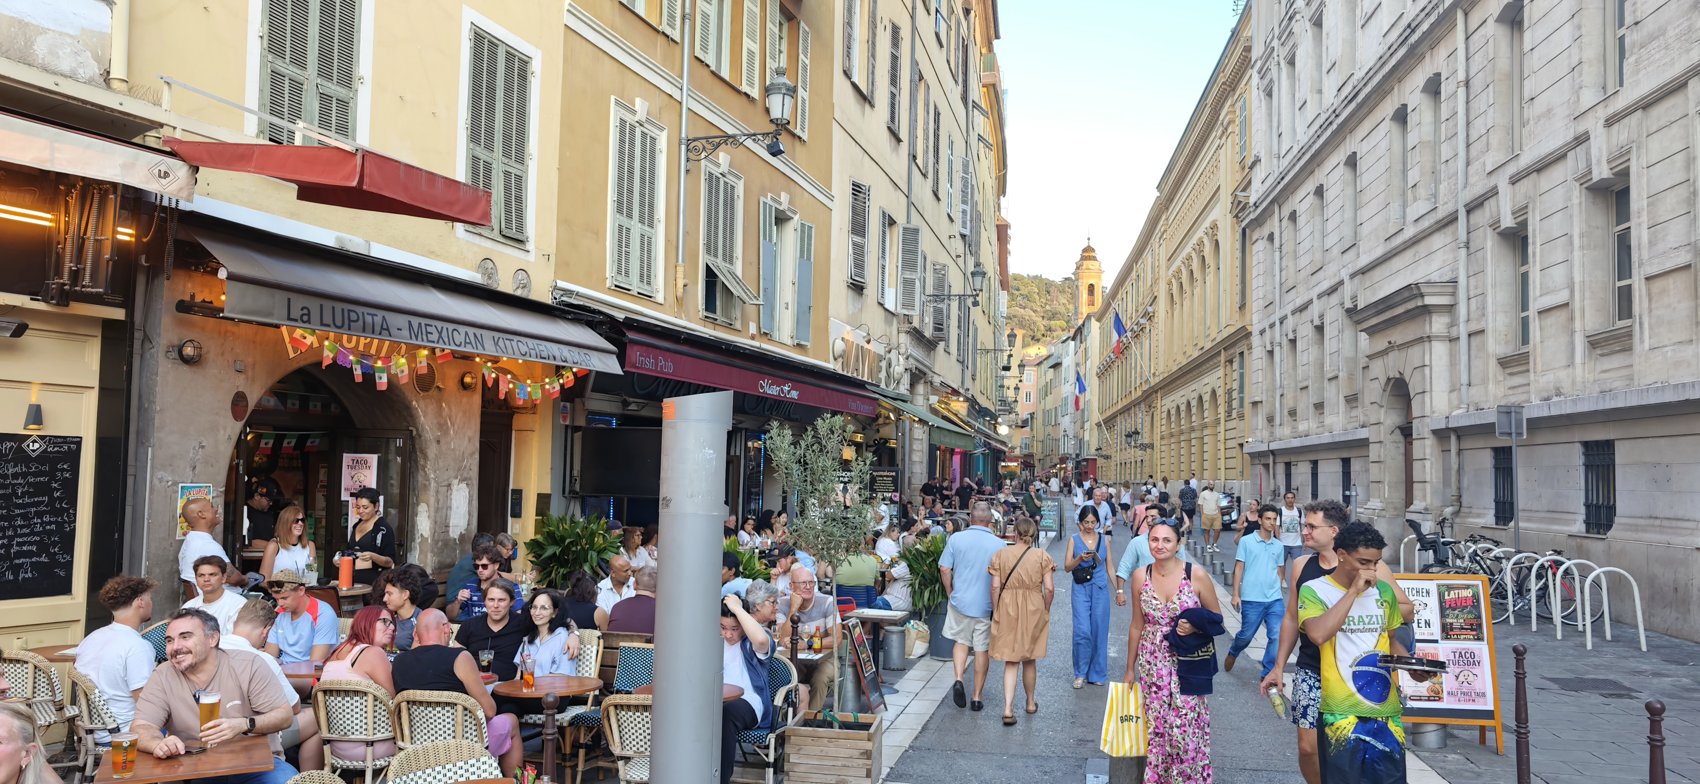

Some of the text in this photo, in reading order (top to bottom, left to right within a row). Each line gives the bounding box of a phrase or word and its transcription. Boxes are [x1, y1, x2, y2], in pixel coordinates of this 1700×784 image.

[158, 169, 171, 180] LP
[286, 298, 312, 325] La
[319, 303, 392, 337] LUPITA
[407, 319, 486, 352] MEXICAN
[492, 335, 557, 362] KITCHEN
[559, 347, 569, 363] &
[569, 350, 596, 369] BAR
[636, 351, 674, 373] Irish Pub
[29, 442, 40, 450] LP
[351, 458, 368, 466] TACO
[1445, 588, 1473, 600] LATINO
[1445, 596, 1474, 609] FEVER
[1345, 614, 1386, 626] RAZIL
[1451, 650, 1476, 660] TACO
[1446, 659, 1481, 667] TUESDAY
[1460, 690, 1473, 698] PRICE
[1119, 714, 1141, 724] BART
